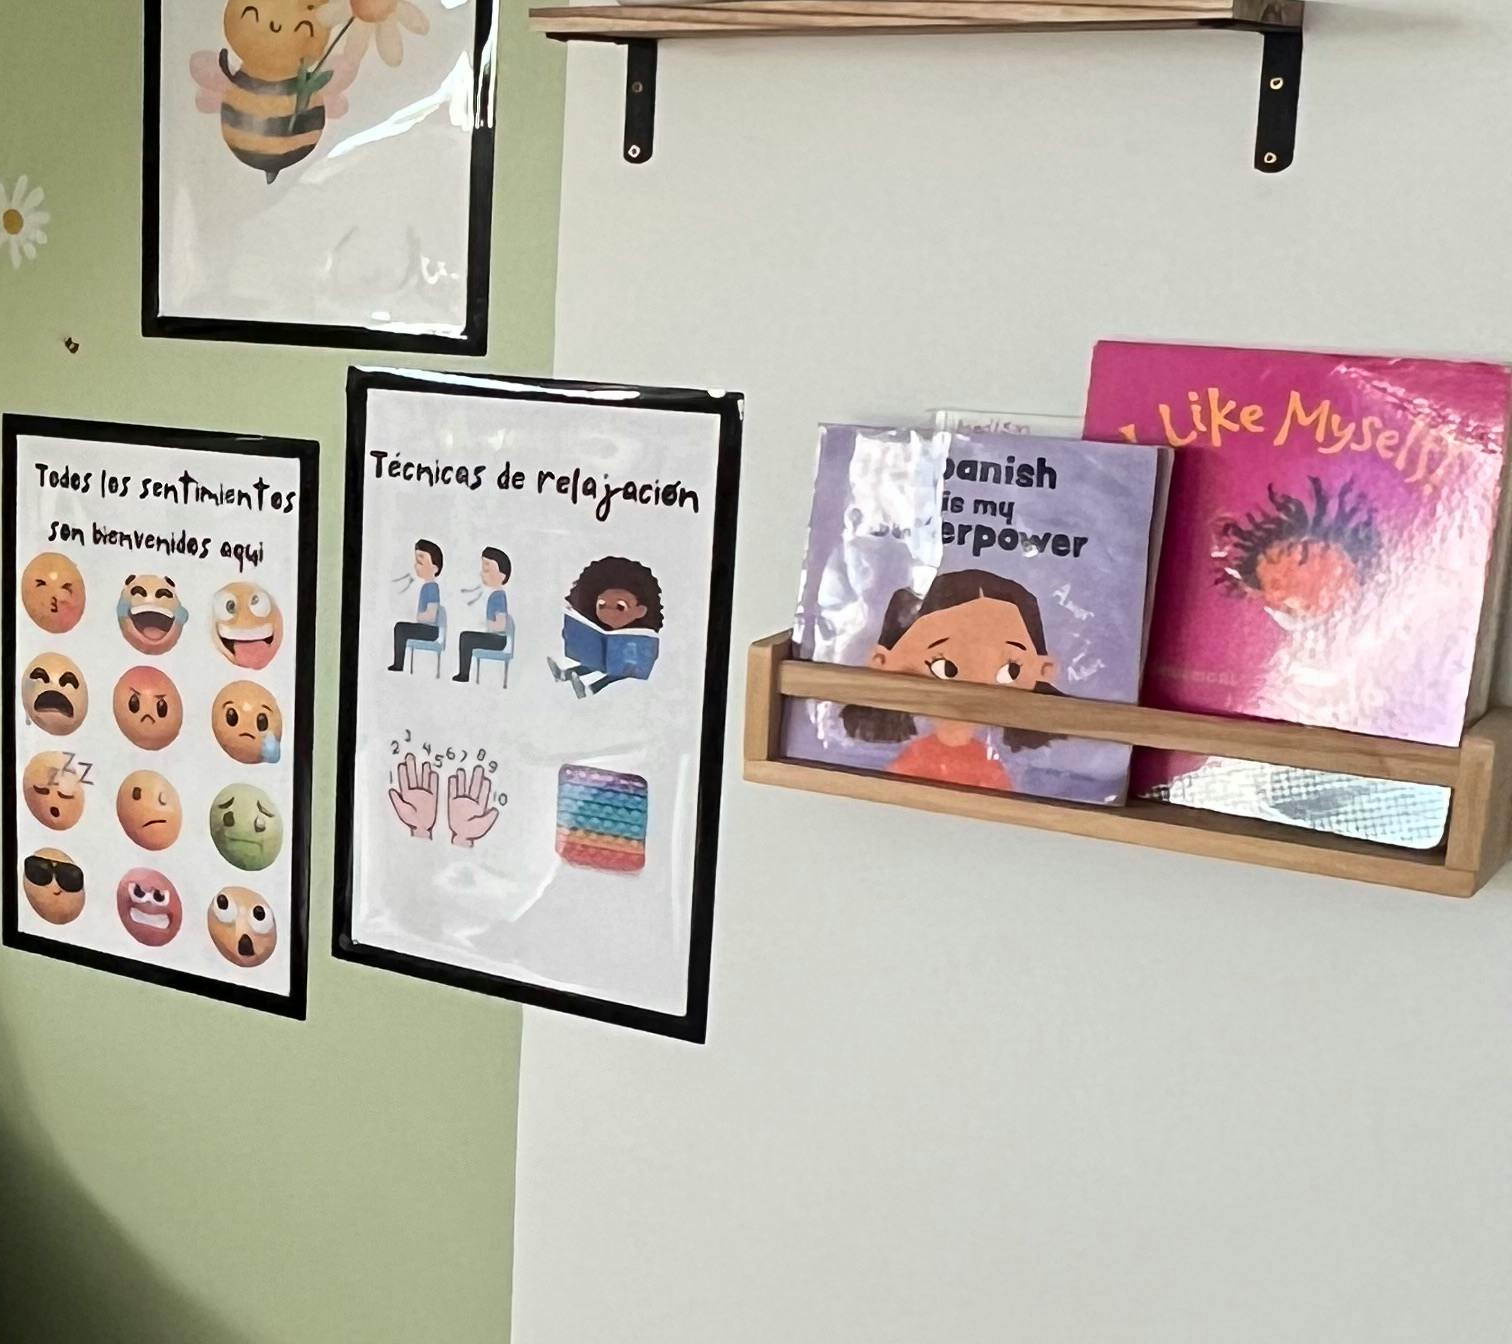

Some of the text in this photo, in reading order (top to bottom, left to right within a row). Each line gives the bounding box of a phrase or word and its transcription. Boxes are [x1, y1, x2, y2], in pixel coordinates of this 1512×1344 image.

[1158, 387, 1265, 449] Like
[34, 462, 297, 514] Todos los sentimientos
[369, 449, 700, 522] Técnicas de relajación
[943, 455, 1058, 490] anish
[941, 490, 1016, 524] is my
[47, 520, 85, 546] son
[92, 522, 212, 559] bienvenidos
[941, 521, 1089, 558] erpower
[390, 740, 400, 755] 2
[445, 746, 456, 760] 6
[476, 748, 486, 761] 8
[488, 760, 498, 773] 9
